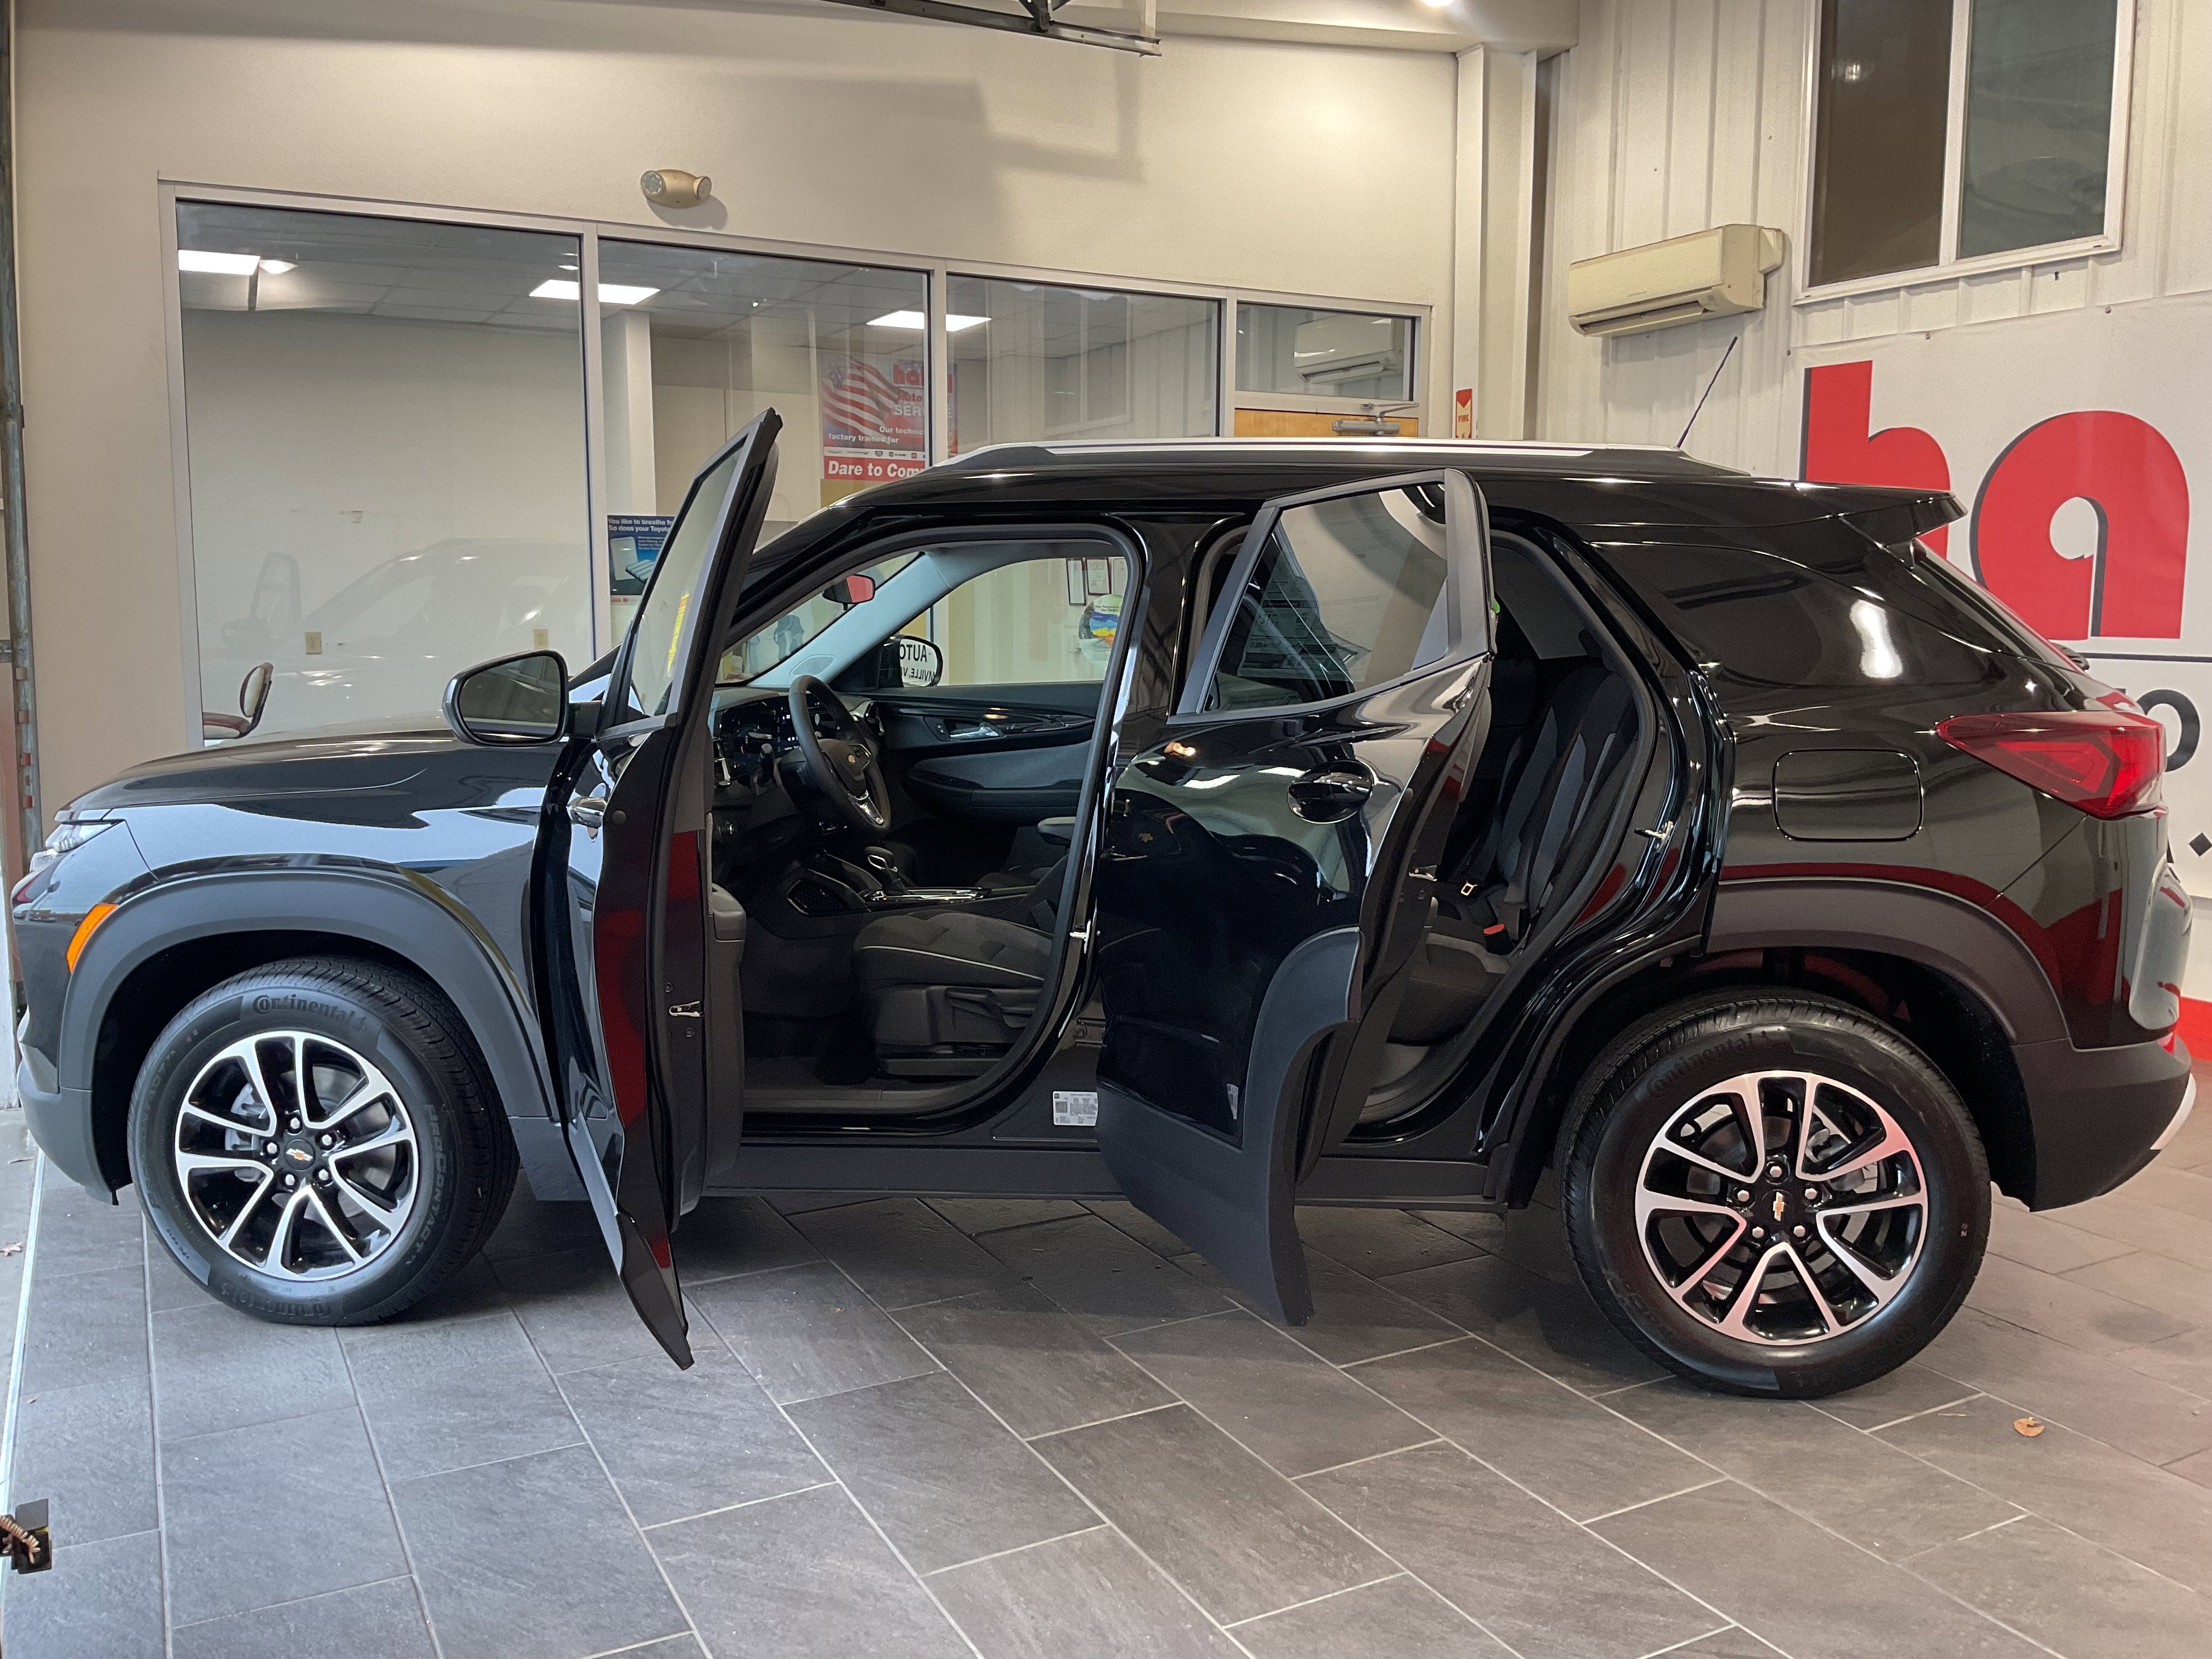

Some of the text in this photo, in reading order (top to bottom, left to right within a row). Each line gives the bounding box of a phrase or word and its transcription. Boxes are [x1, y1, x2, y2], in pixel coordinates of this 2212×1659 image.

[828, 433, 856, 442] factory
[859, 434, 885, 442] trained
[828, 461, 925, 477] Dare to Com
[252, 994, 356, 1024] Continental
